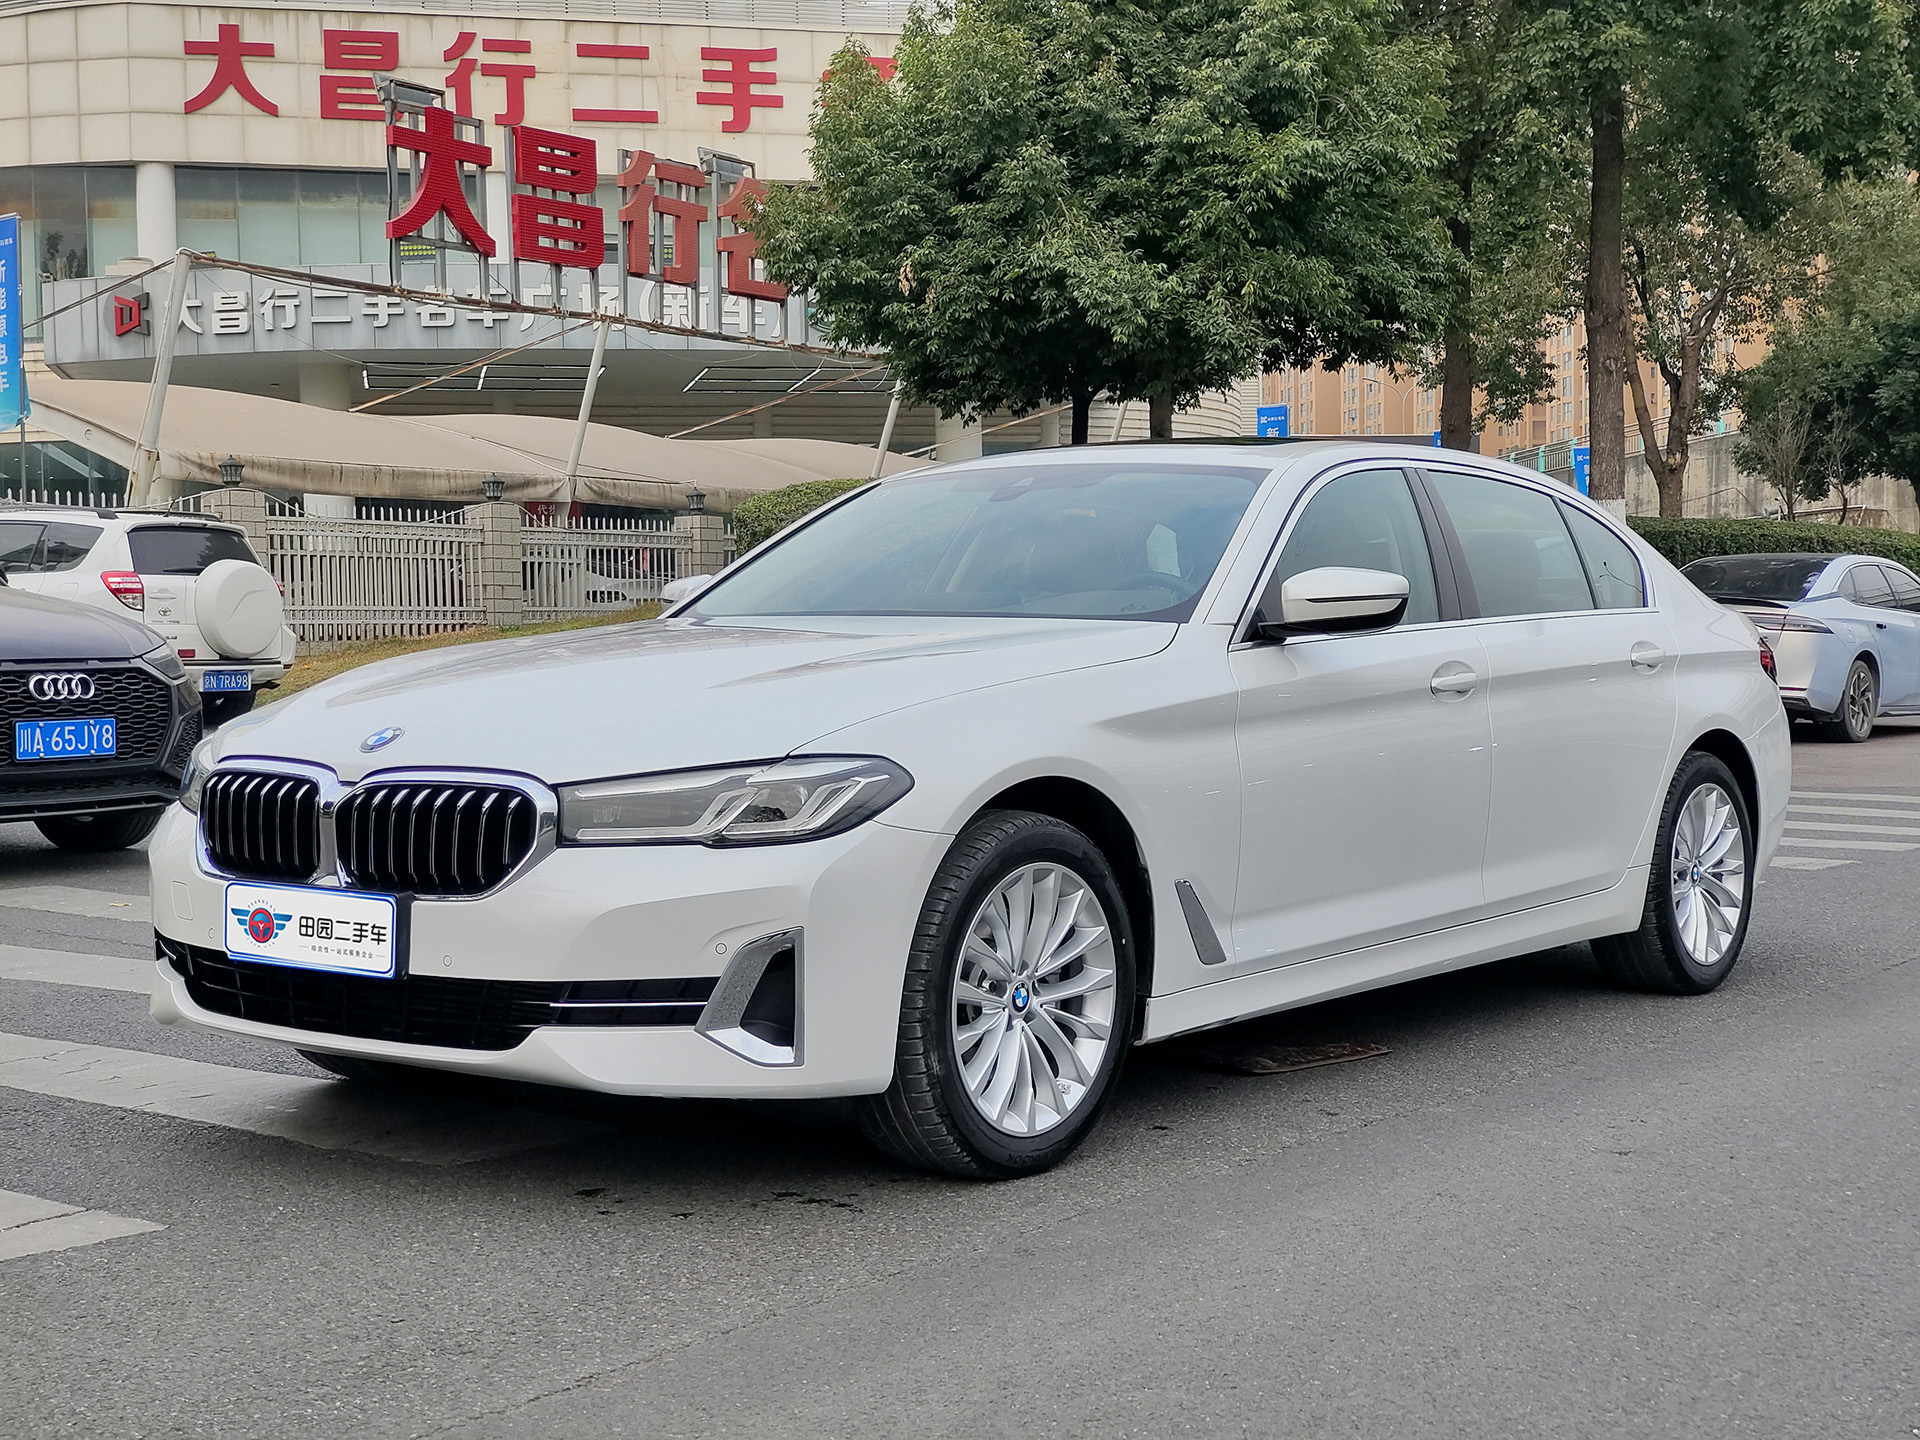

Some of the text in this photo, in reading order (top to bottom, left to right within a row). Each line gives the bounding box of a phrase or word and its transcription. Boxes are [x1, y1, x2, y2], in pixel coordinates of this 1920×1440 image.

[299, 916, 387, 945] 田园二手车
